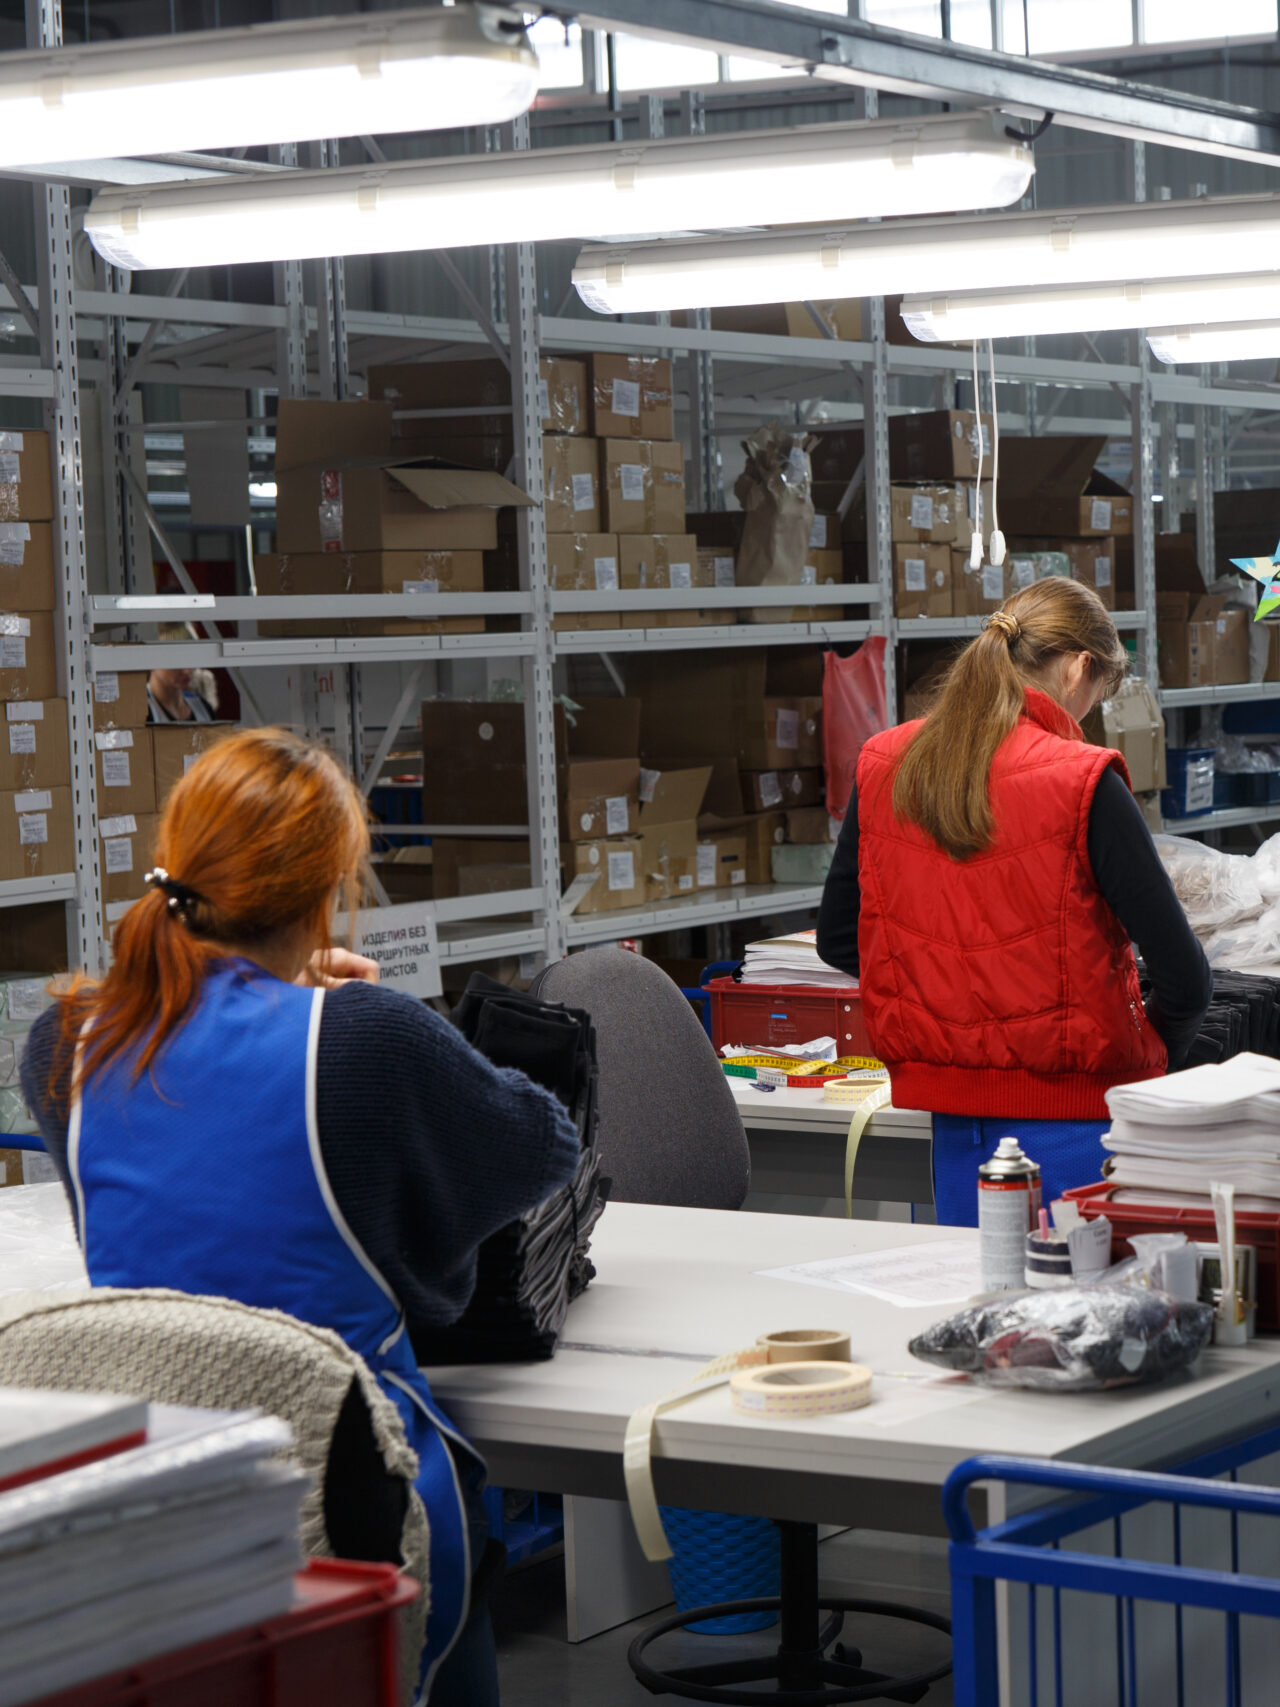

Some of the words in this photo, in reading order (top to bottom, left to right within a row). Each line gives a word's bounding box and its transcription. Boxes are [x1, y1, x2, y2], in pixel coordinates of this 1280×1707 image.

[362, 928, 407, 946] ИЗДЕЛИЯ
[409, 925, 426, 938] БЕЗ
[379, 962, 418, 979] ЛИСТОВ
